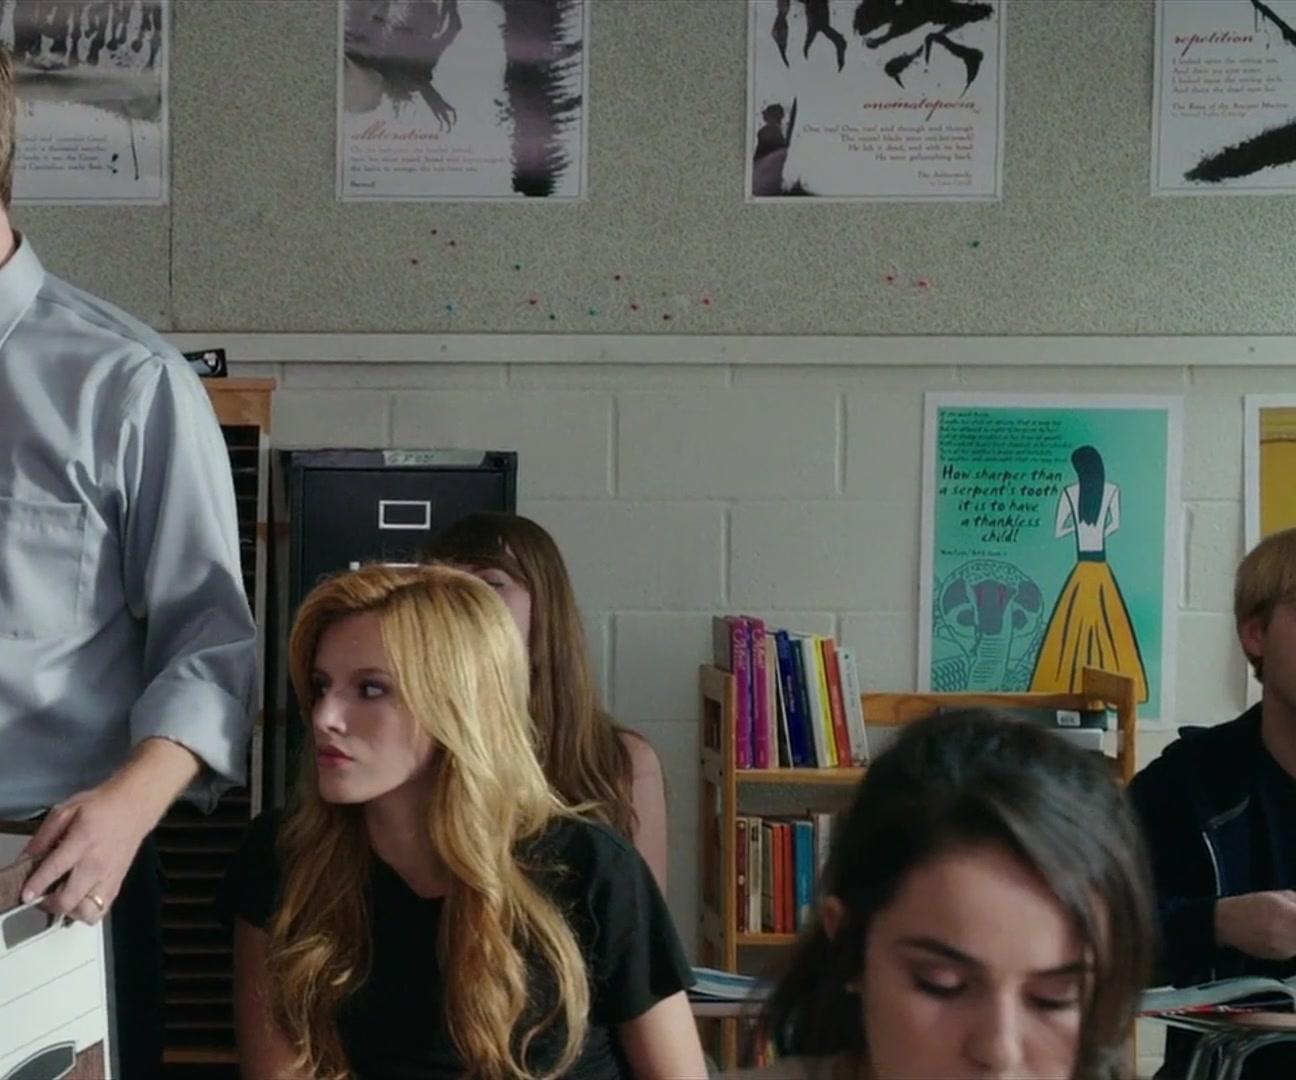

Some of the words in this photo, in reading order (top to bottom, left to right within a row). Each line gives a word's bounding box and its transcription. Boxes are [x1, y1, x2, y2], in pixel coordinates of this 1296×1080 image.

[1174, 31, 1254, 57] repetition
[863, 98, 975, 121] onomatopoeia
[942, 464, 971, 481] How
[974, 467, 1028, 484] sharper
[1030, 467, 1064, 481] than
[939, 486, 948, 496] a
[952, 481, 1016, 500] serpent's
[1020, 485, 1059, 497] tooth
[958, 500, 971, 512] it
[974, 501, 987, 512] is
[990, 500, 1006, 512] to
[1008, 500, 1041, 512] have
[960, 518, 970, 528] a
[973, 514, 1041, 529] thankless
[981, 528, 1021, 544] child!
